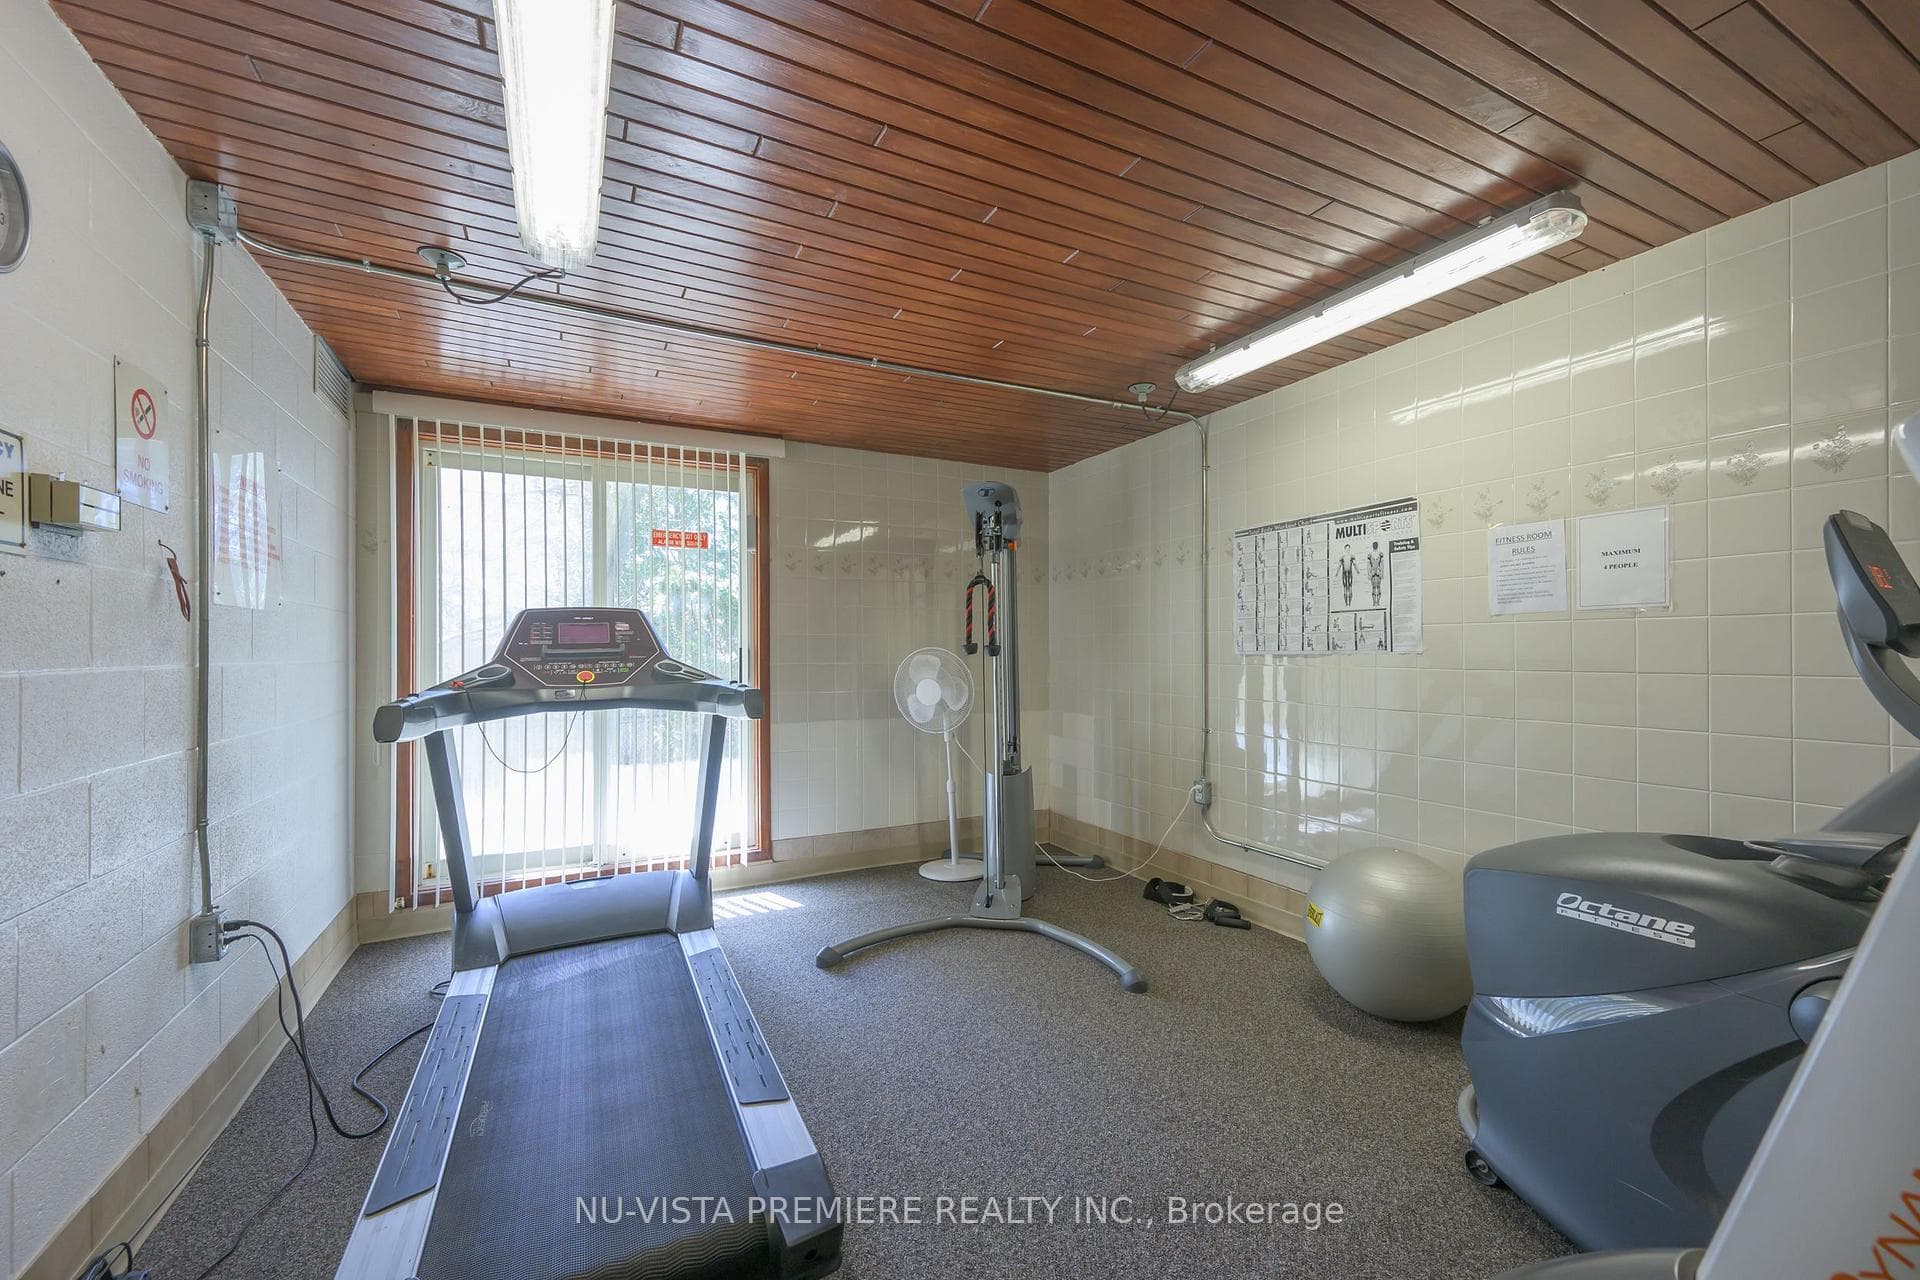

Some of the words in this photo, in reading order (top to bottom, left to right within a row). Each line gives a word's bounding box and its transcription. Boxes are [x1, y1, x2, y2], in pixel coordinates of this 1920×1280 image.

[137, 454, 151, 471] NO
[123, 468, 164, 495] SMOKING
[1496, 534, 1525, 544] FITNESS
[1527, 530, 1552, 540] ROOM
[1512, 545, 1536, 555] RULES
[1601, 548, 1641, 557] MAXIMUM
[1609, 562, 1639, 570] PEOPLE
[1556, 892, 1695, 937] Octane
[1560, 908, 1686, 945] FITNESS
